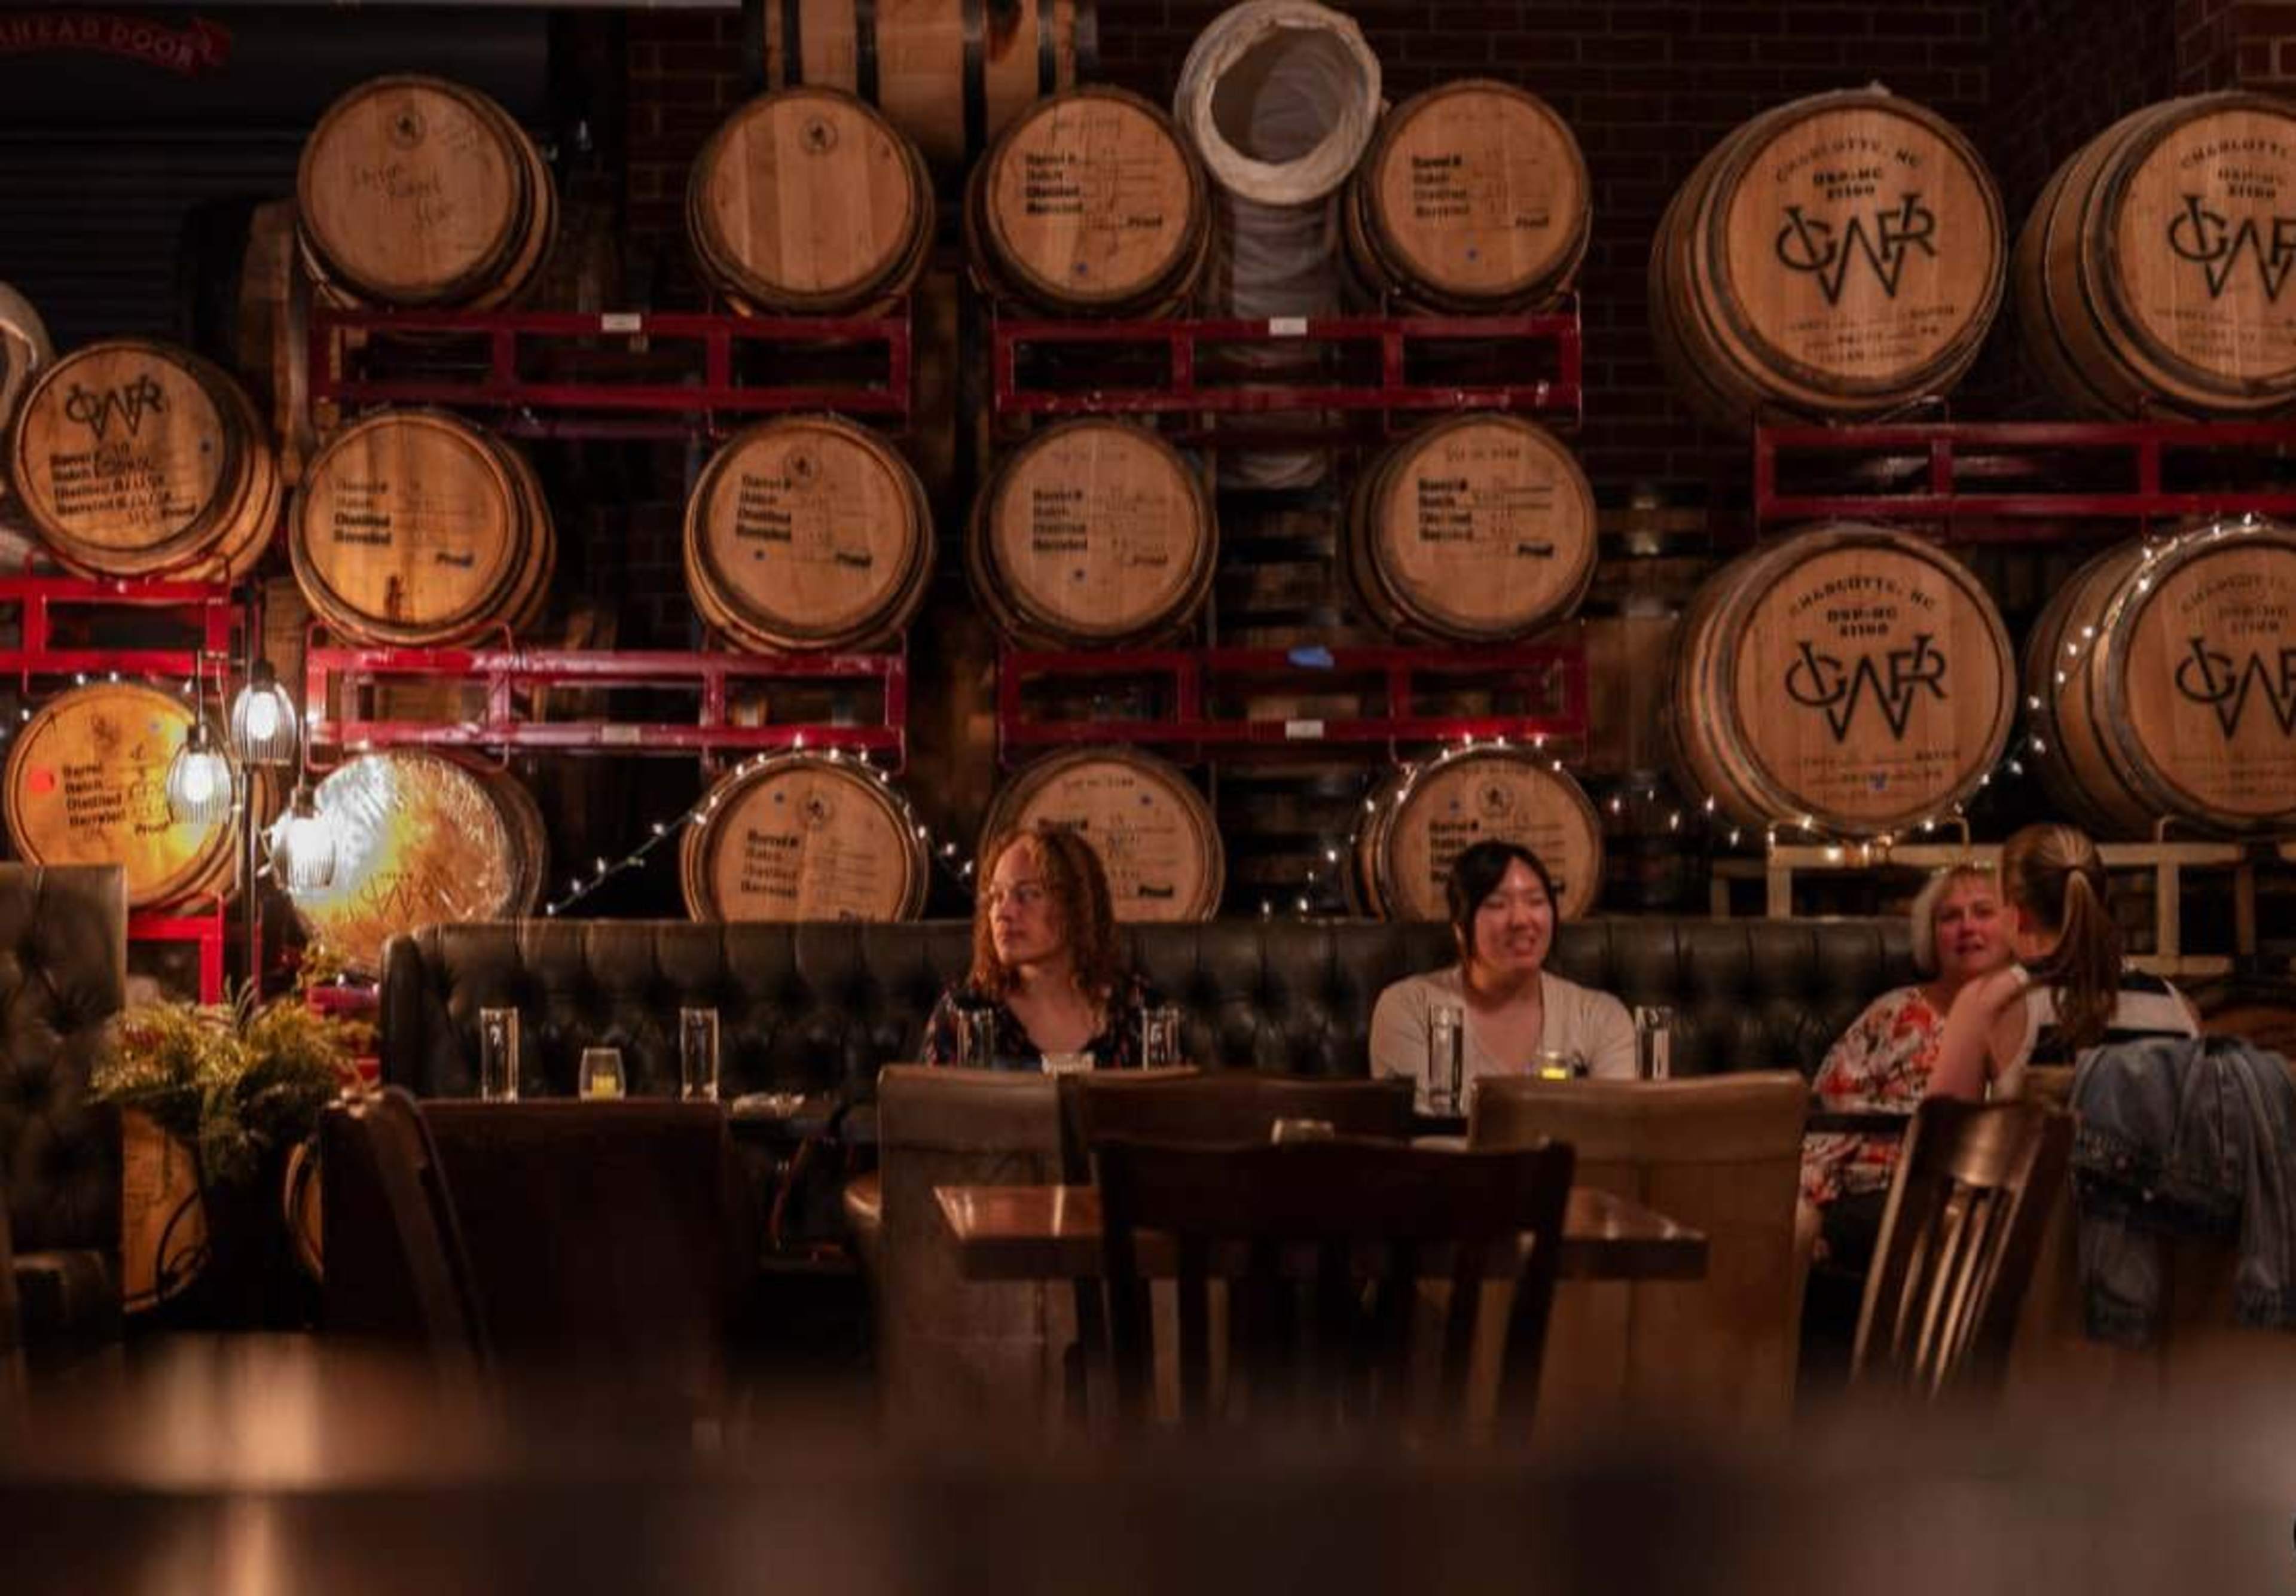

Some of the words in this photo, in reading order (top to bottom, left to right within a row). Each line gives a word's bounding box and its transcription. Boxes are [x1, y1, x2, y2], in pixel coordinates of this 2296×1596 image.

[1895, 149, 1922, 167] NC
[1910, 589, 1935, 610] NC
[66, 793, 122, 811] Distilled
